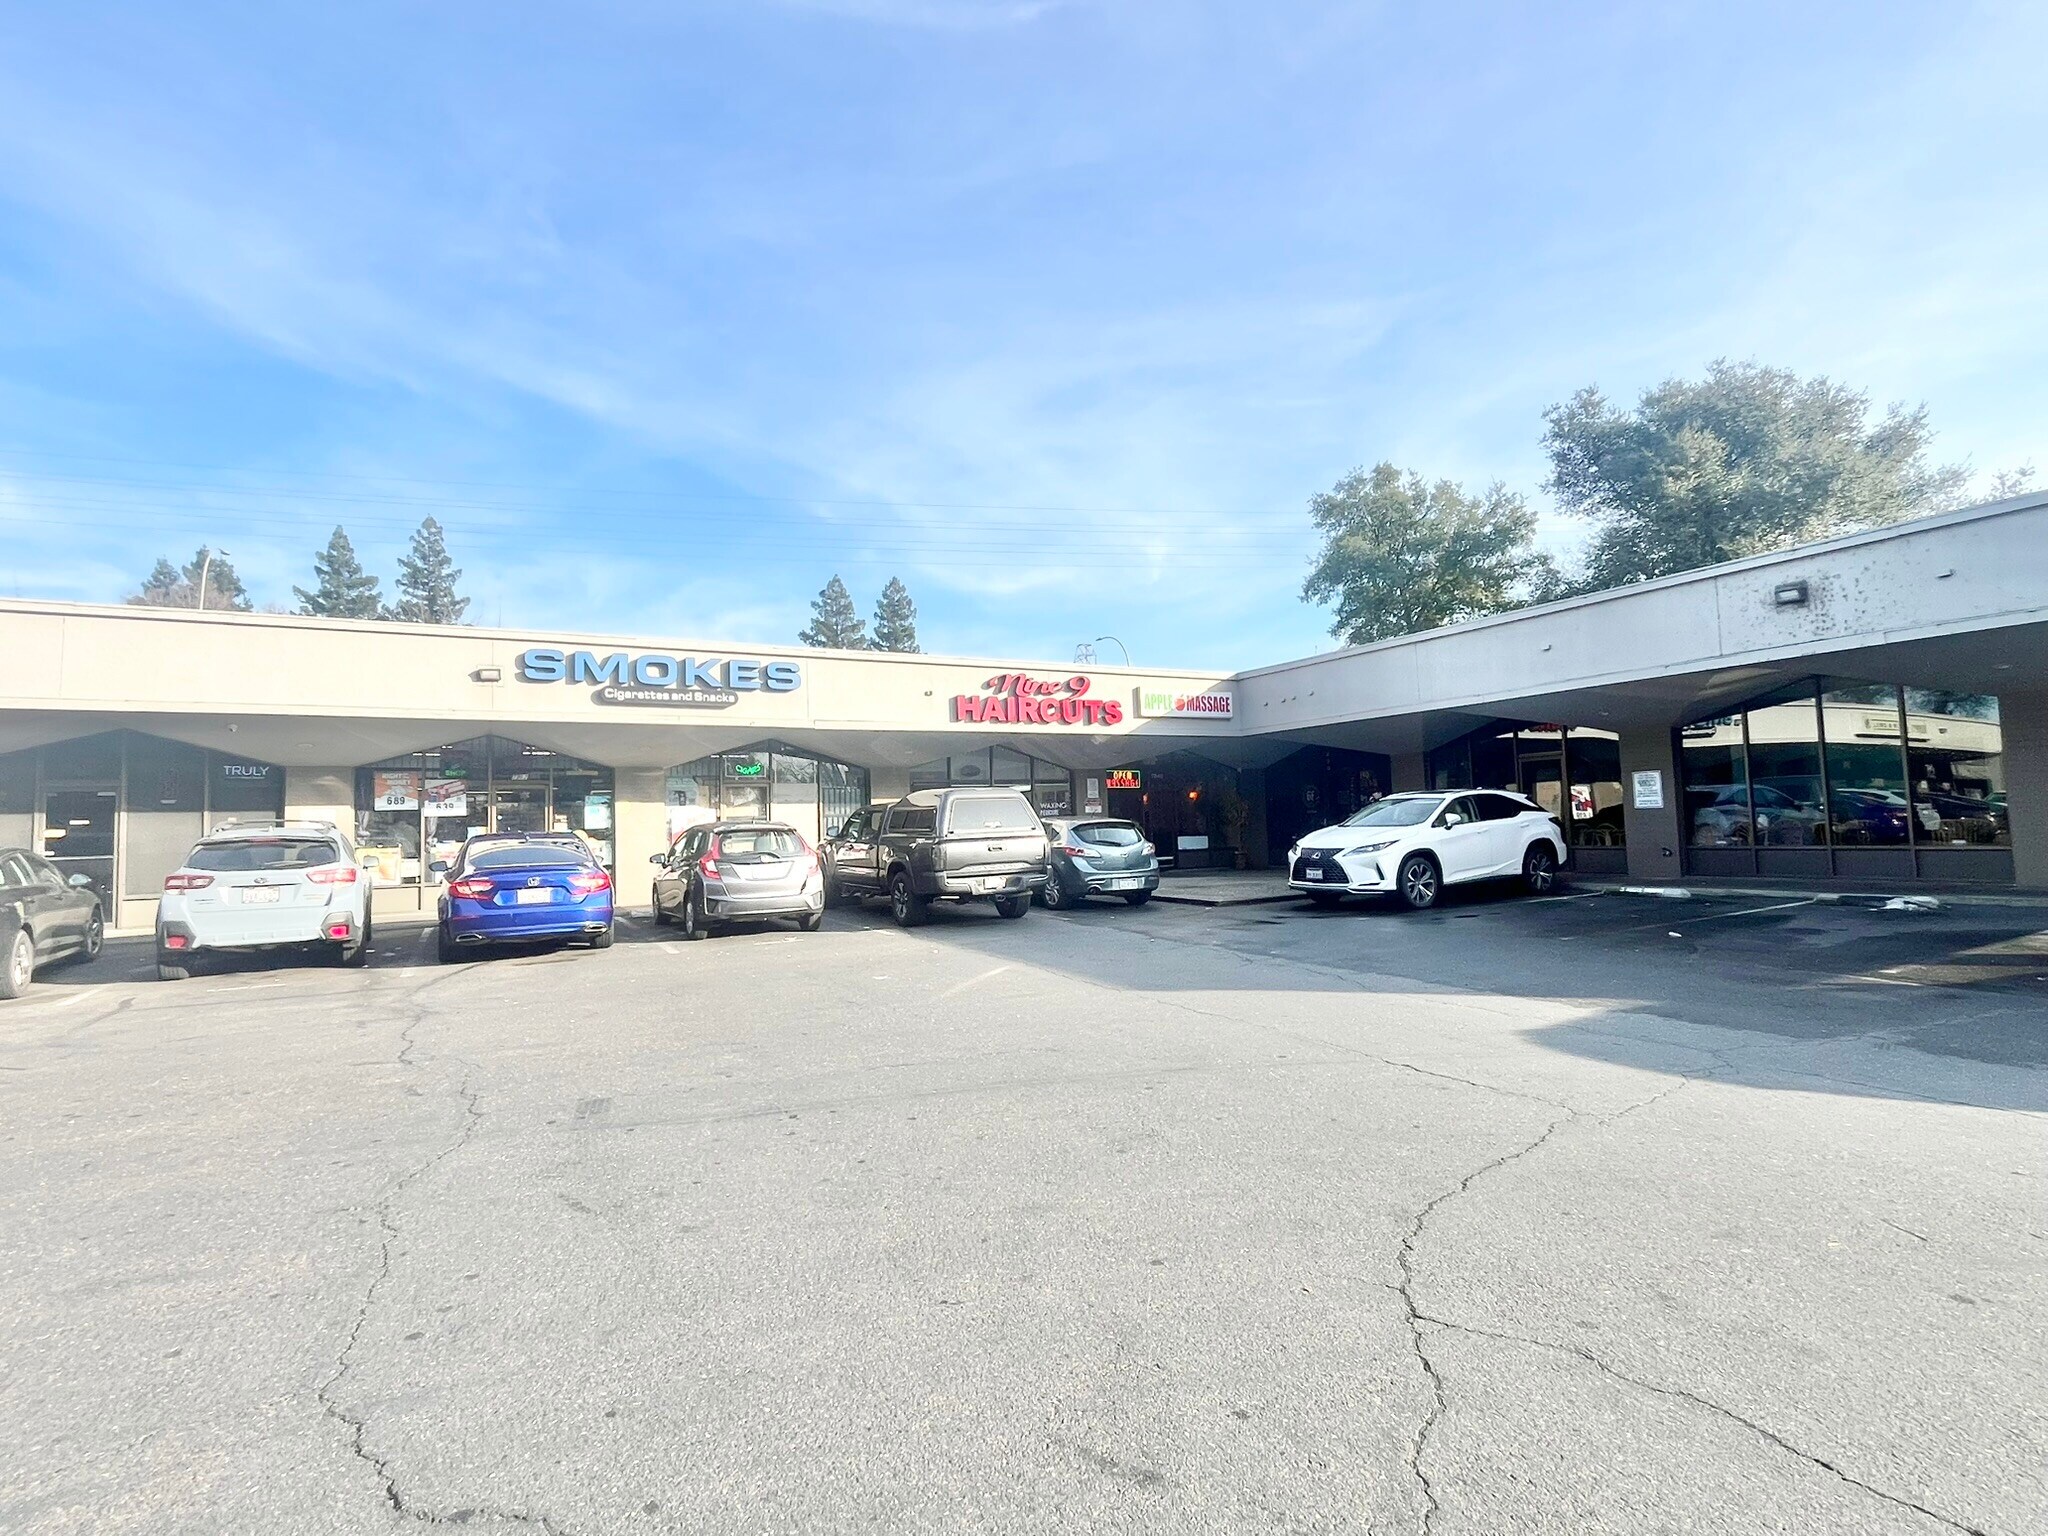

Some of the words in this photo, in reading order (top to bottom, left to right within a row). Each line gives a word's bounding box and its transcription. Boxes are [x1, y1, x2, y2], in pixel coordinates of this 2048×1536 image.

[524, 649, 801, 690] SMOKES
[988, 673, 1062, 698] Nine
[1068, 675, 1091, 700] 9
[604, 687, 670, 702] Cigarettes
[671, 690, 693, 702] and
[694, 690, 736, 703] Snacks
[1144, 693, 1173, 711] APPLE
[1186, 694, 1231, 713] MASSAGE
[956, 694, 1123, 725] HAIRCUTS
[223, 765, 270, 776] TRULY
[1113, 771, 1132, 780] OPEN
[386, 796, 406, 806] 689
[1040, 801, 1067, 809] WAXING
